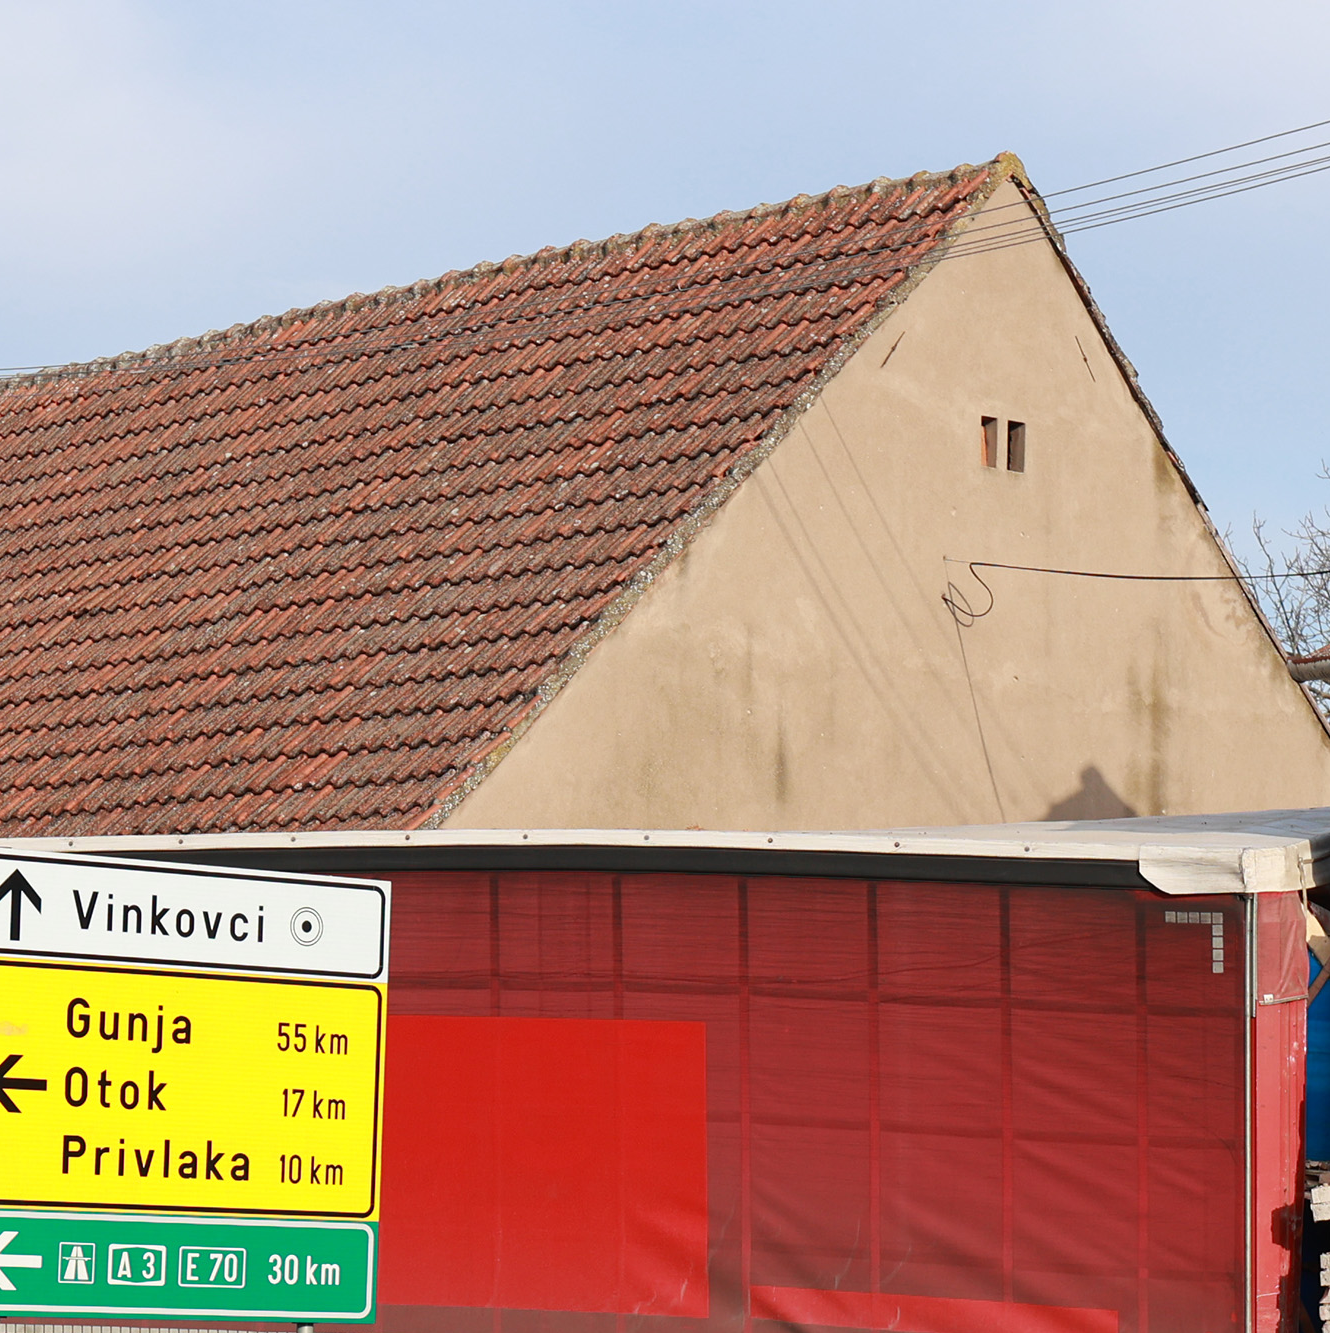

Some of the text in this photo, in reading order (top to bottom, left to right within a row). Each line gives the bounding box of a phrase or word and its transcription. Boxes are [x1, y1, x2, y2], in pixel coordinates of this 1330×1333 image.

[72, 889, 264, 943] Vinkovci
[66, 997, 349, 1056] Gunja 55 km
[64, 1066, 346, 1121] Otok 17 km
[61, 1134, 344, 1186] Privlaka 10 km
[117, 1250, 156, 1280] A 3
[185, 1252, 239, 1283] E 70
[267, 1254, 341, 1287] 30 km
